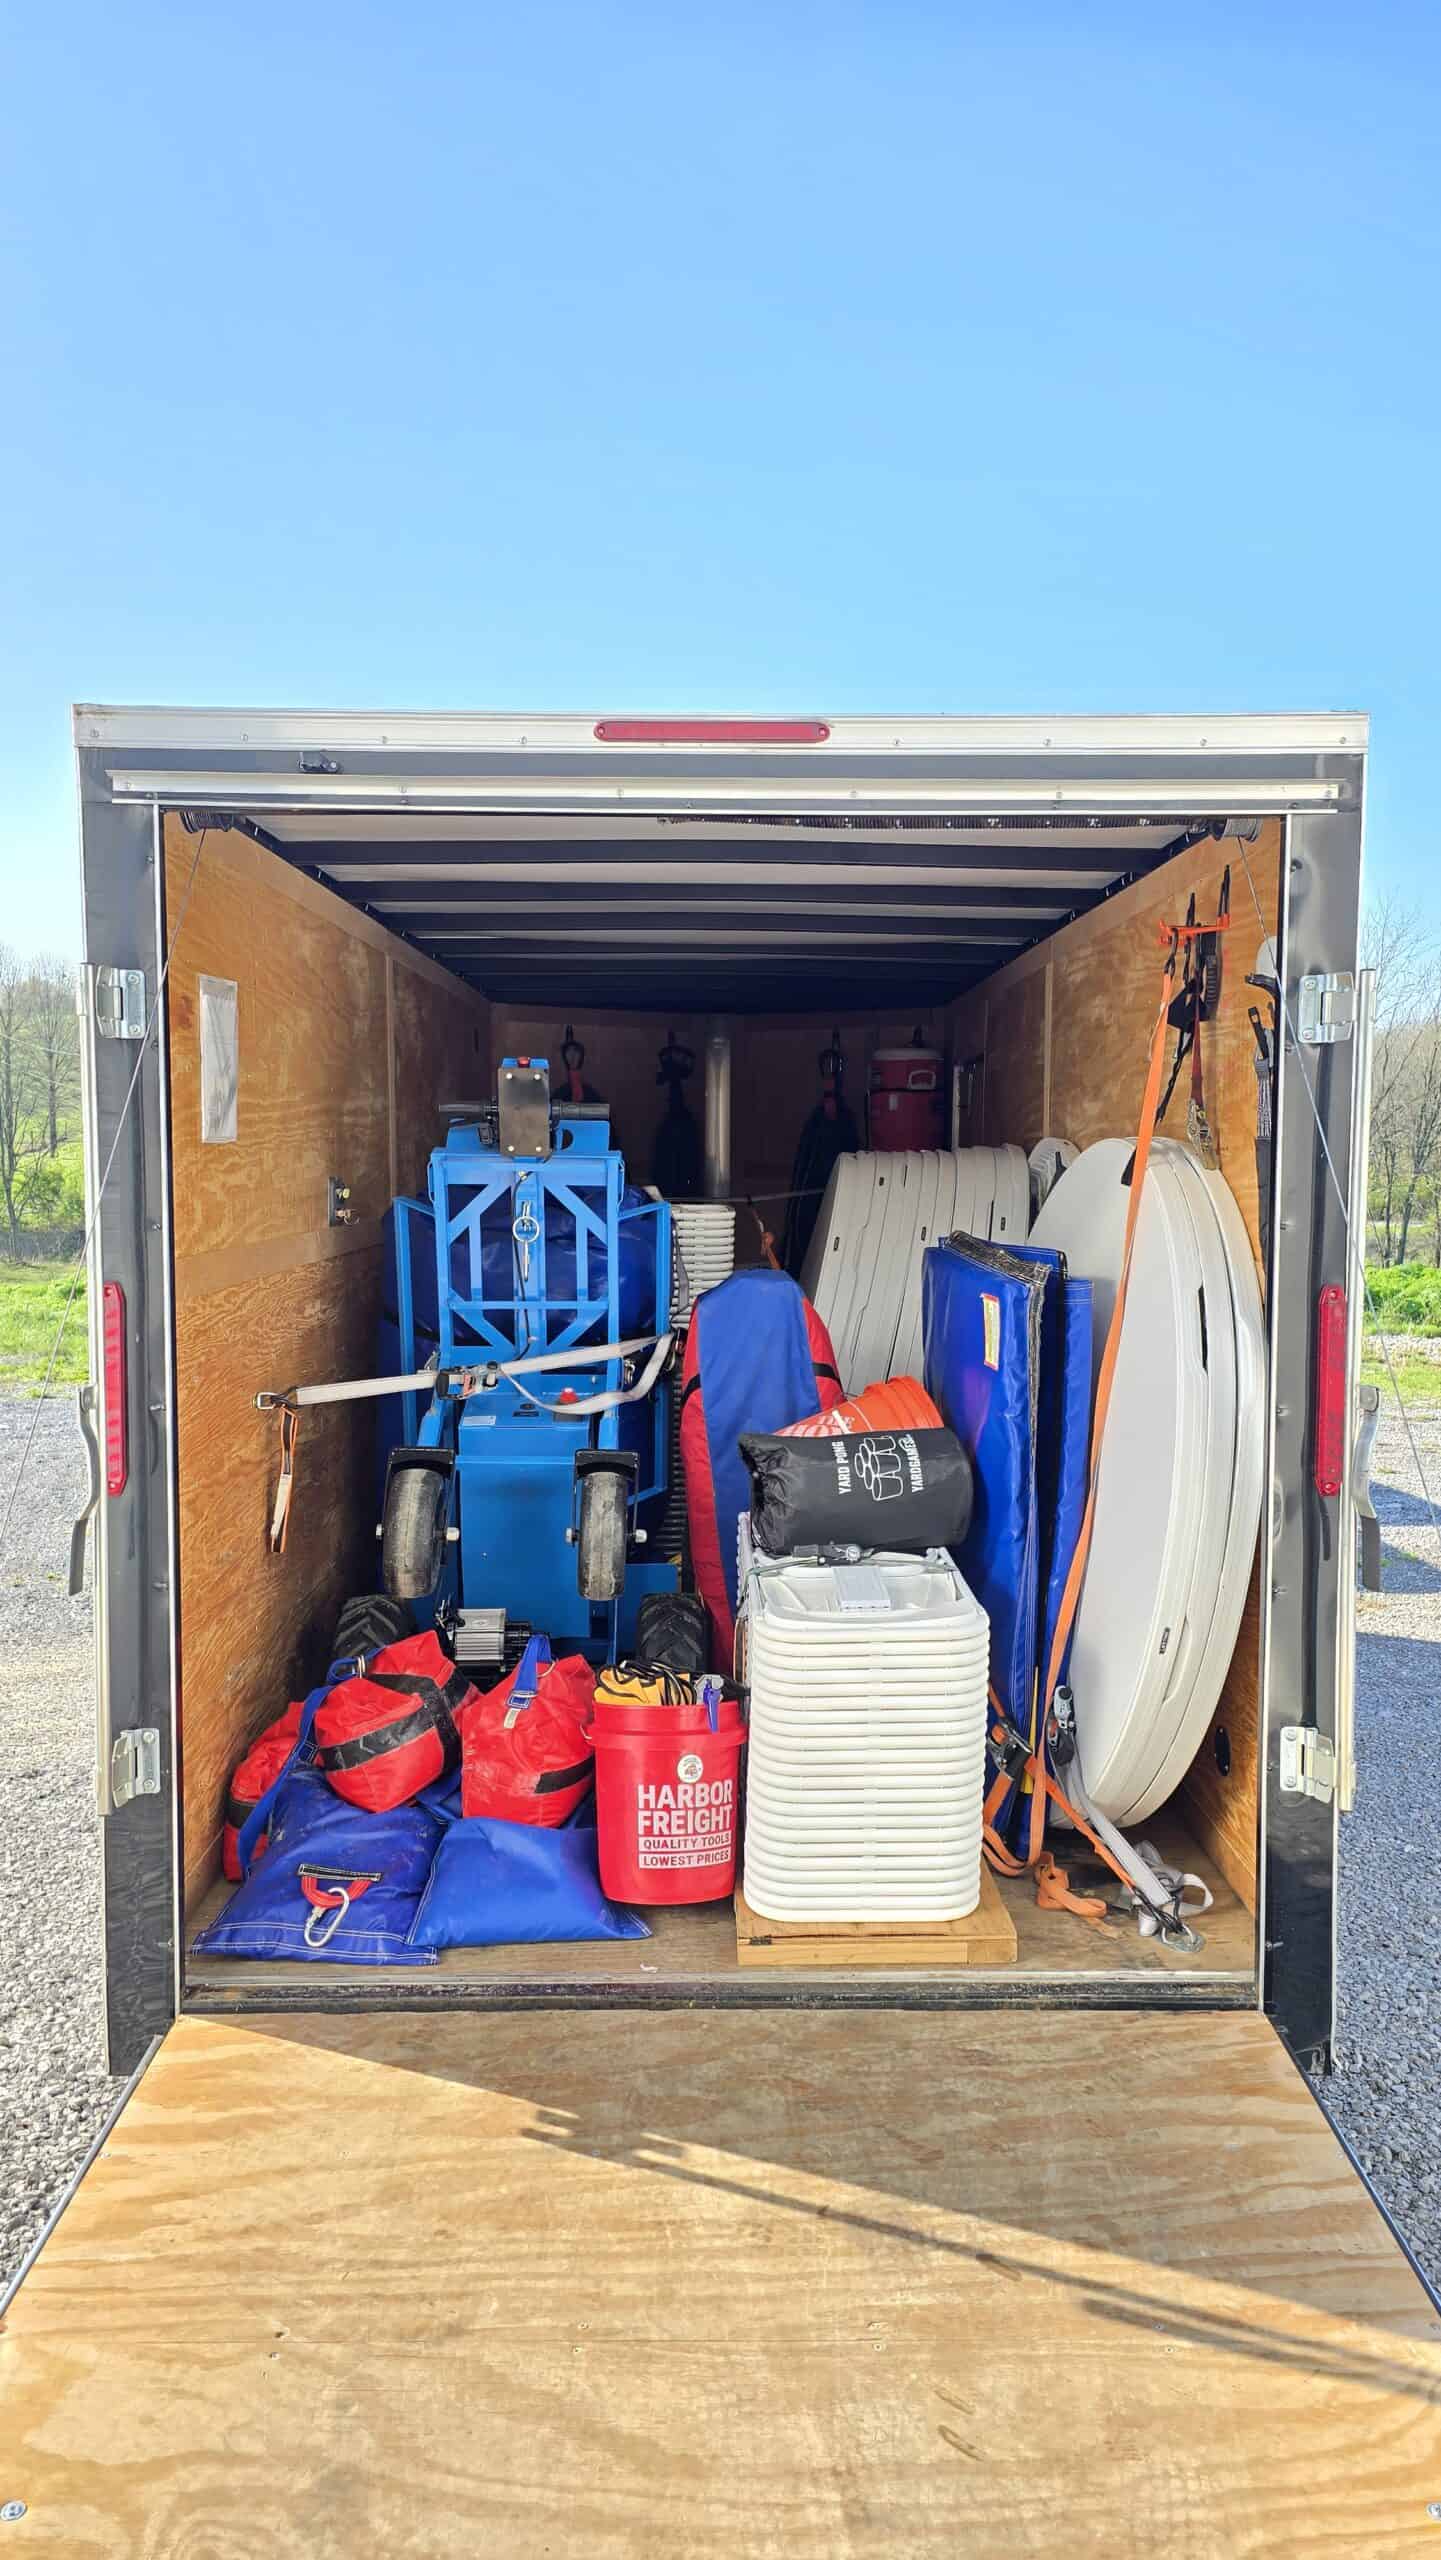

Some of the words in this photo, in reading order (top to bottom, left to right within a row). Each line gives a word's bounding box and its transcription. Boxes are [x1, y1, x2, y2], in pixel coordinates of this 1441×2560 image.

[837, 1466, 852, 1495] YARD
[638, 1779, 733, 1809] HARBOR
[638, 1804, 733, 1835] FREIGHT
[643, 1837, 697, 1850] QUALITY
[702, 1832, 730, 1847] TOOLS
[643, 1855, 693, 1867] LOWEST
[696, 1849, 729, 1865] PRICES
